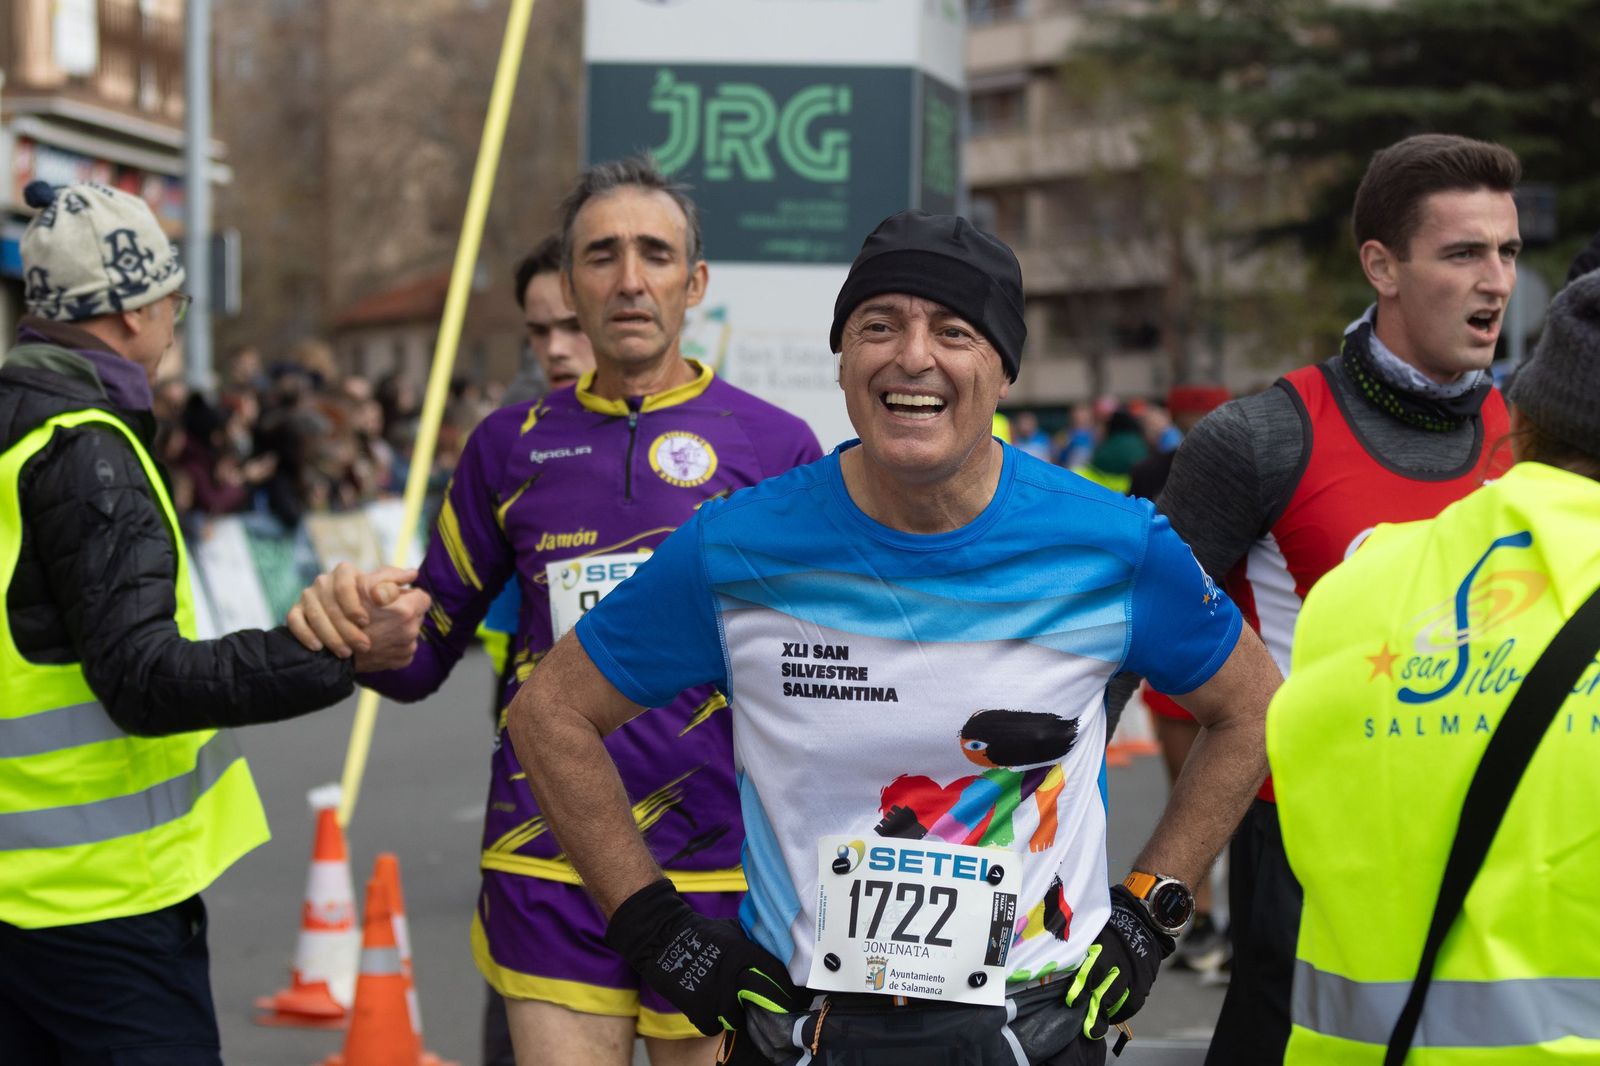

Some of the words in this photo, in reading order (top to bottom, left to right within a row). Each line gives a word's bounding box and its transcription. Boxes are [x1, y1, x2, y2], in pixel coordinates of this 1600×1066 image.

[649, 70, 851, 181] JRG
[534, 528, 598, 551] Jamón
[781, 643, 808, 658] XLI
[813, 644, 849, 660] SAN
[781, 662, 868, 681] SILVESTRE
[783, 682, 899, 702] SALMANTINA
[848, 879, 958, 947] 1722
[662, 944, 684, 971] 2018
[863, 941, 929, 958] JONINATA
[680, 943, 715, 987] MARATON
[685, 947, 721, 991] MEDIA
[889, 969, 945, 983] Ayuntamiento
[889, 982, 899, 990] de
[901, 982, 943, 995] Salamanca
